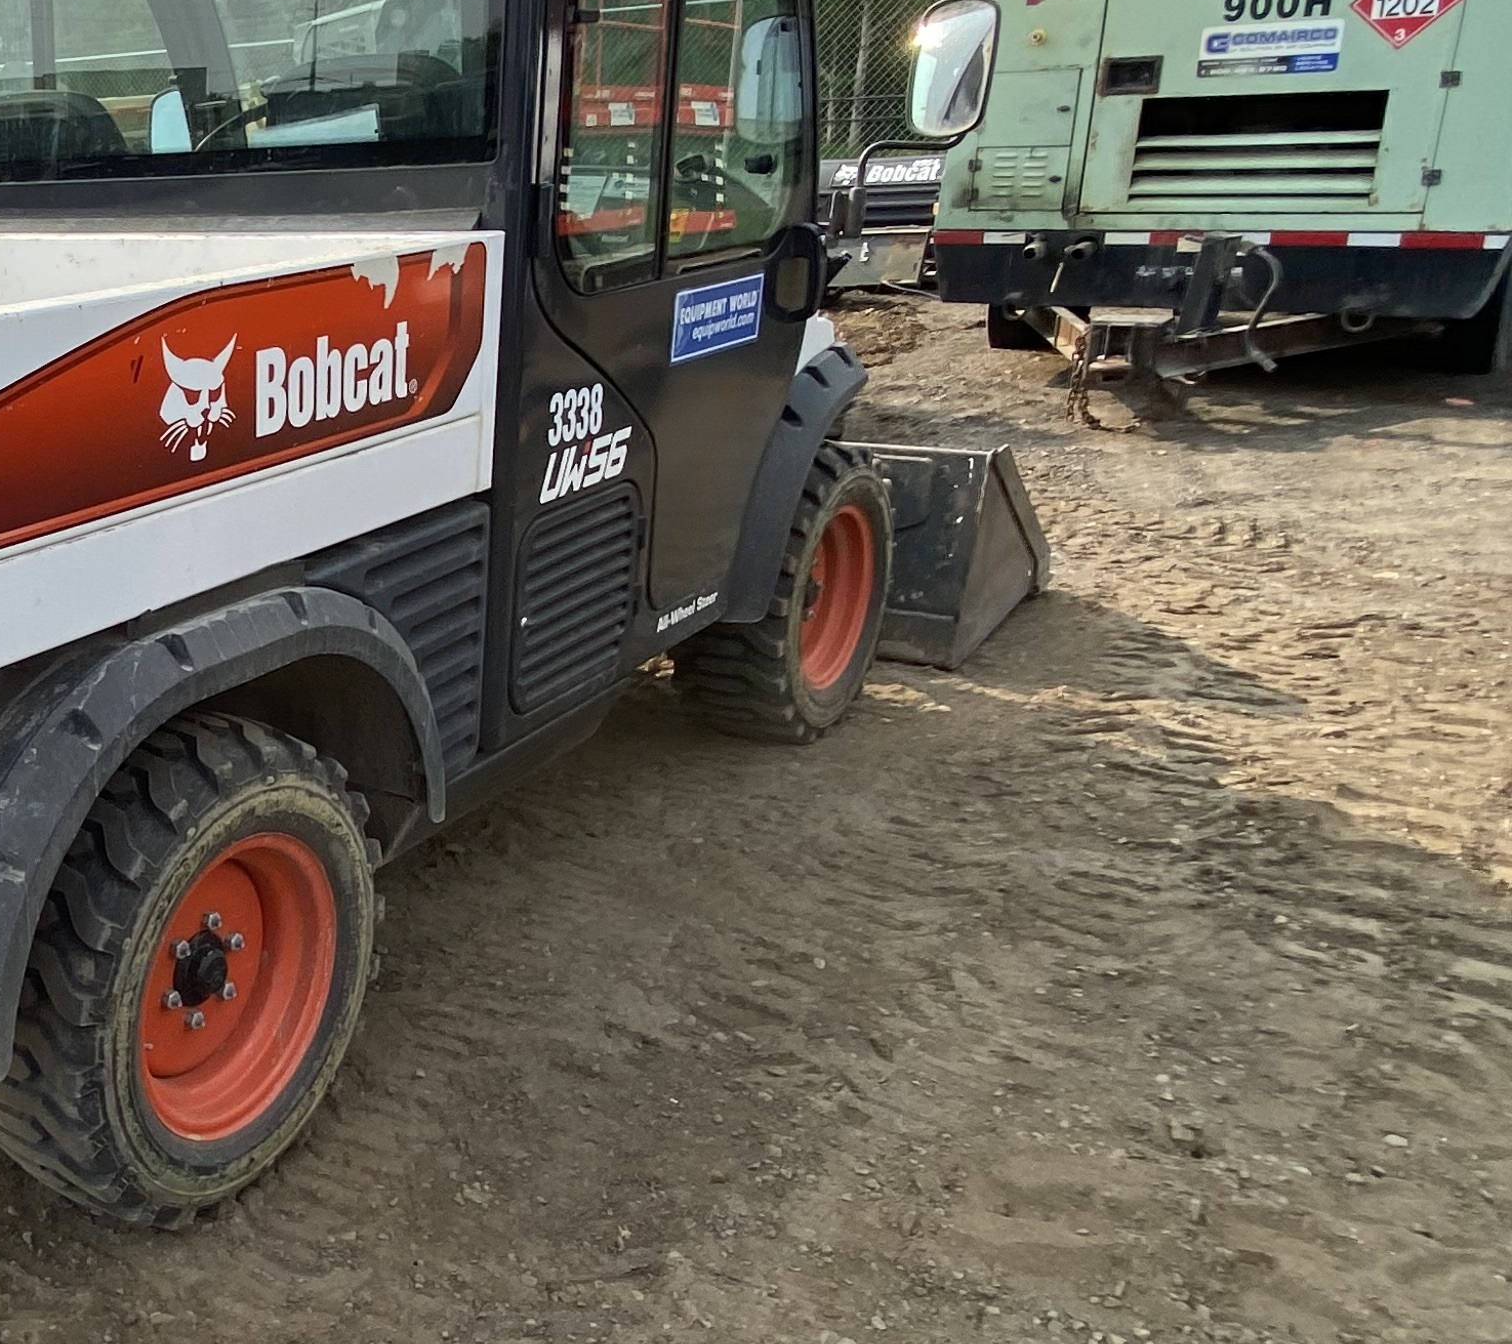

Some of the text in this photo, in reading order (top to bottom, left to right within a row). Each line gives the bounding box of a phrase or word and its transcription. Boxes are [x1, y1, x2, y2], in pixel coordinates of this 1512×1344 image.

[1232, 28, 1338, 46] COMAIRCO
[1393, 29, 1406, 42] 3
[865, 160, 941, 184] Bobcat
[680, 290, 758, 325] EQUIPMENT WORLD
[692, 312, 755, 342] equipworld.com
[256, 321, 410, 438] Bobcat
[548, 382, 604, 447] 3338
[656, 591, 719, 633] All-Wheel Steer
